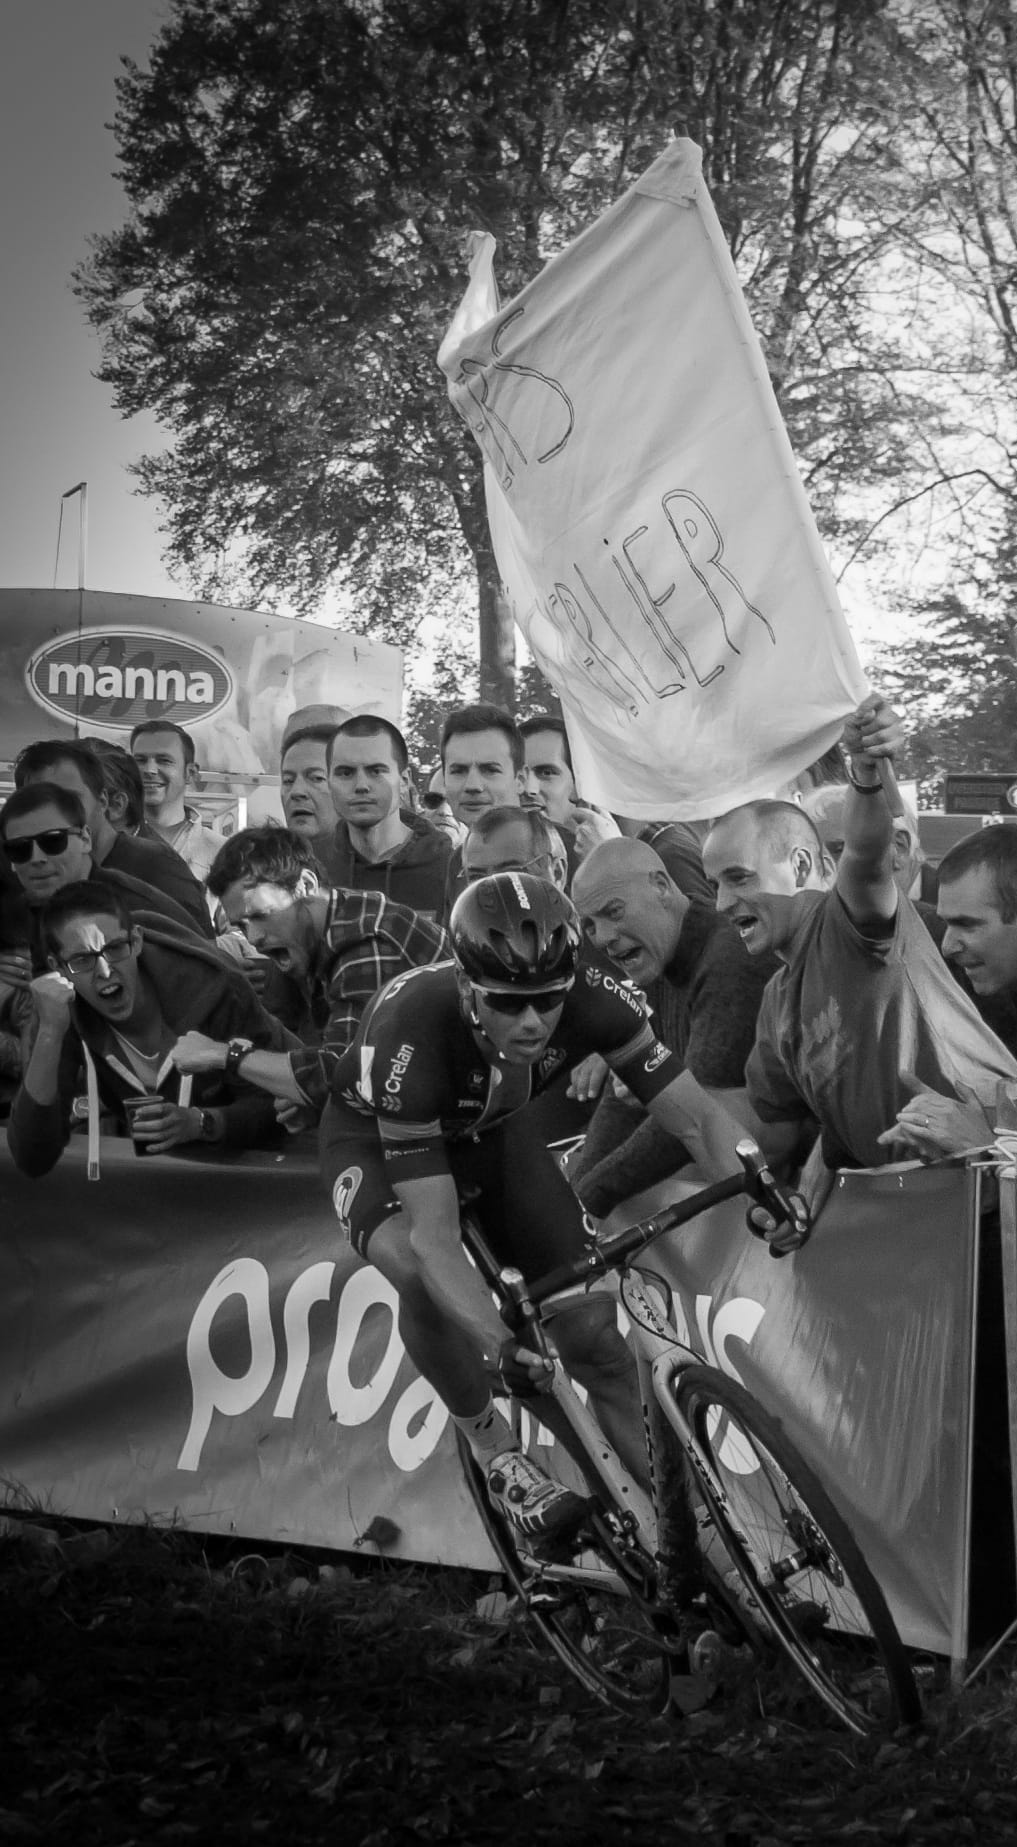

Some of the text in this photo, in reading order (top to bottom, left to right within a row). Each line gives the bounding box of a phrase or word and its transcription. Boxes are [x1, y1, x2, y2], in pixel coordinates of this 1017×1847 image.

[47, 661, 216, 705] manna
[602, 975, 644, 1017] Crelan
[384, 1043, 416, 1094] Crelan
